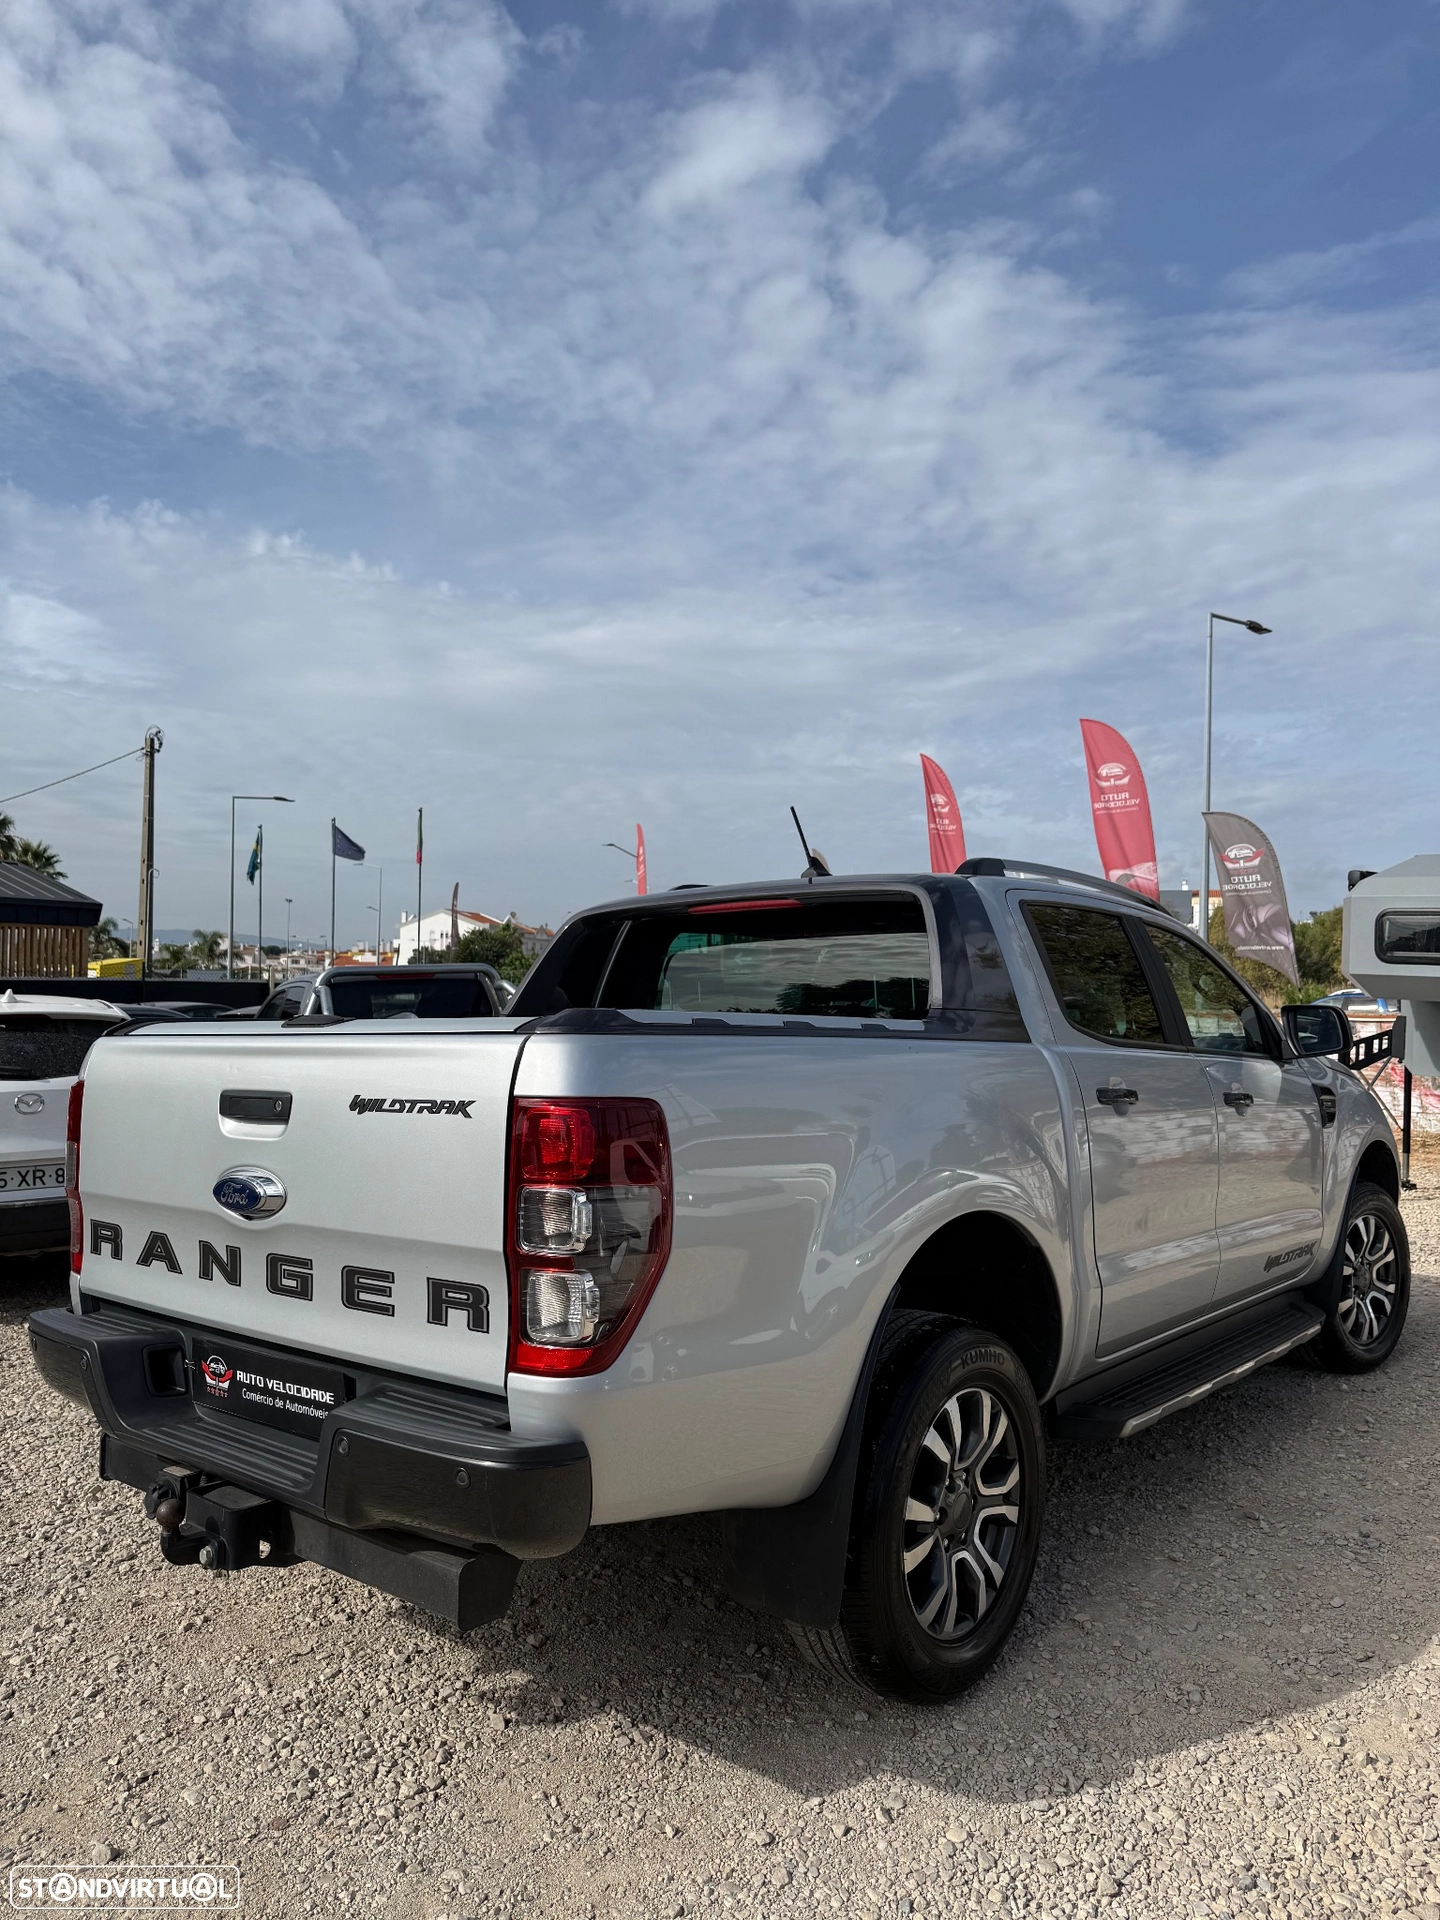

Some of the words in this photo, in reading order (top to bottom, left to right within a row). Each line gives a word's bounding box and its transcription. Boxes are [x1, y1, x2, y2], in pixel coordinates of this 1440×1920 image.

[349, 1094, 477, 1119] WILDTRAK
[220, 1181, 250, 1205] Ford
[1263, 1240, 1318, 1273] WILDTRAK
[90, 1218, 490, 1334] RANGER
[960, 1348, 1005, 1370] KUMHO
[236, 1370, 264, 1388] AUTO
[266, 1378, 335, 1405] VELOCIDADE
[241, 1388, 274, 1406] Comércio
[274, 1397, 284, 1409] de
